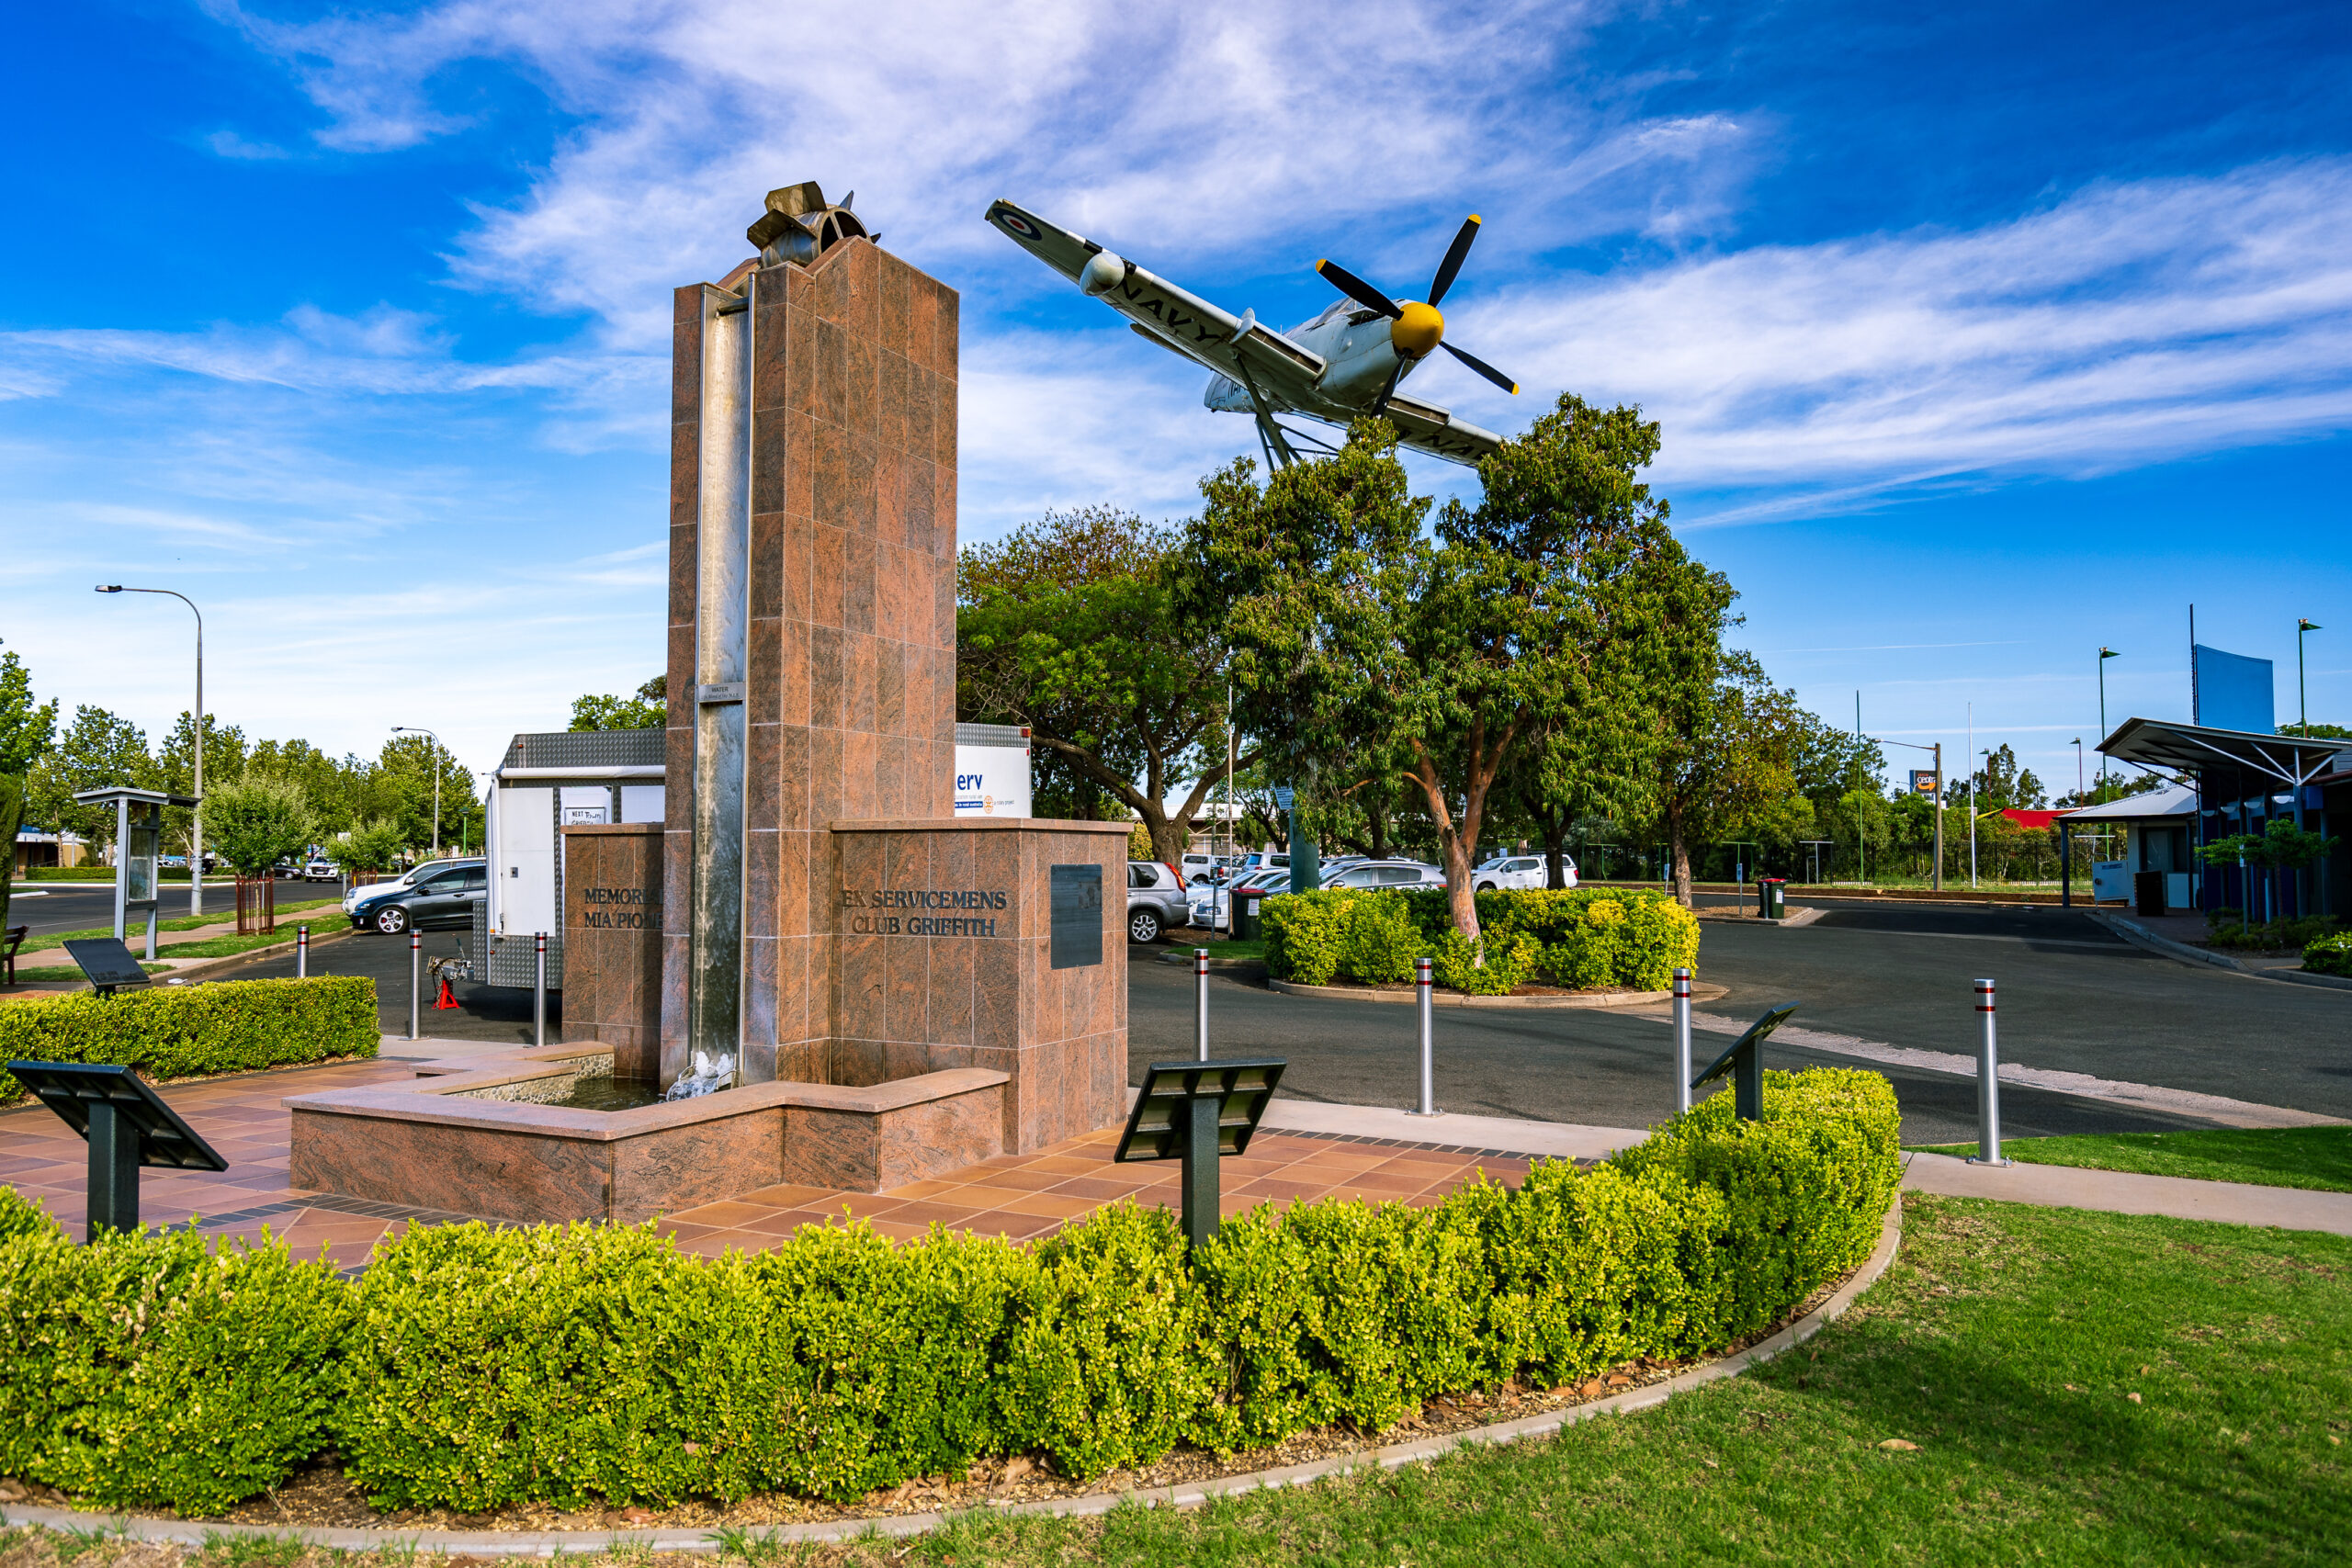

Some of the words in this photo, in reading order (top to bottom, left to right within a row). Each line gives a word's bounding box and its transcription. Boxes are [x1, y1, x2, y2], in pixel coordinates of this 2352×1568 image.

[1113, 278, 1221, 343] NAVY
[955, 774, 983, 791] erv
[841, 889, 867, 908] EX
[869, 890, 1007, 909] SERVICEMENS
[584, 912, 613, 929] MIA
[617, 912, 663, 930] PIONE
[852, 917, 901, 935] CLUB
[908, 917, 996, 936] GRIFFITH
